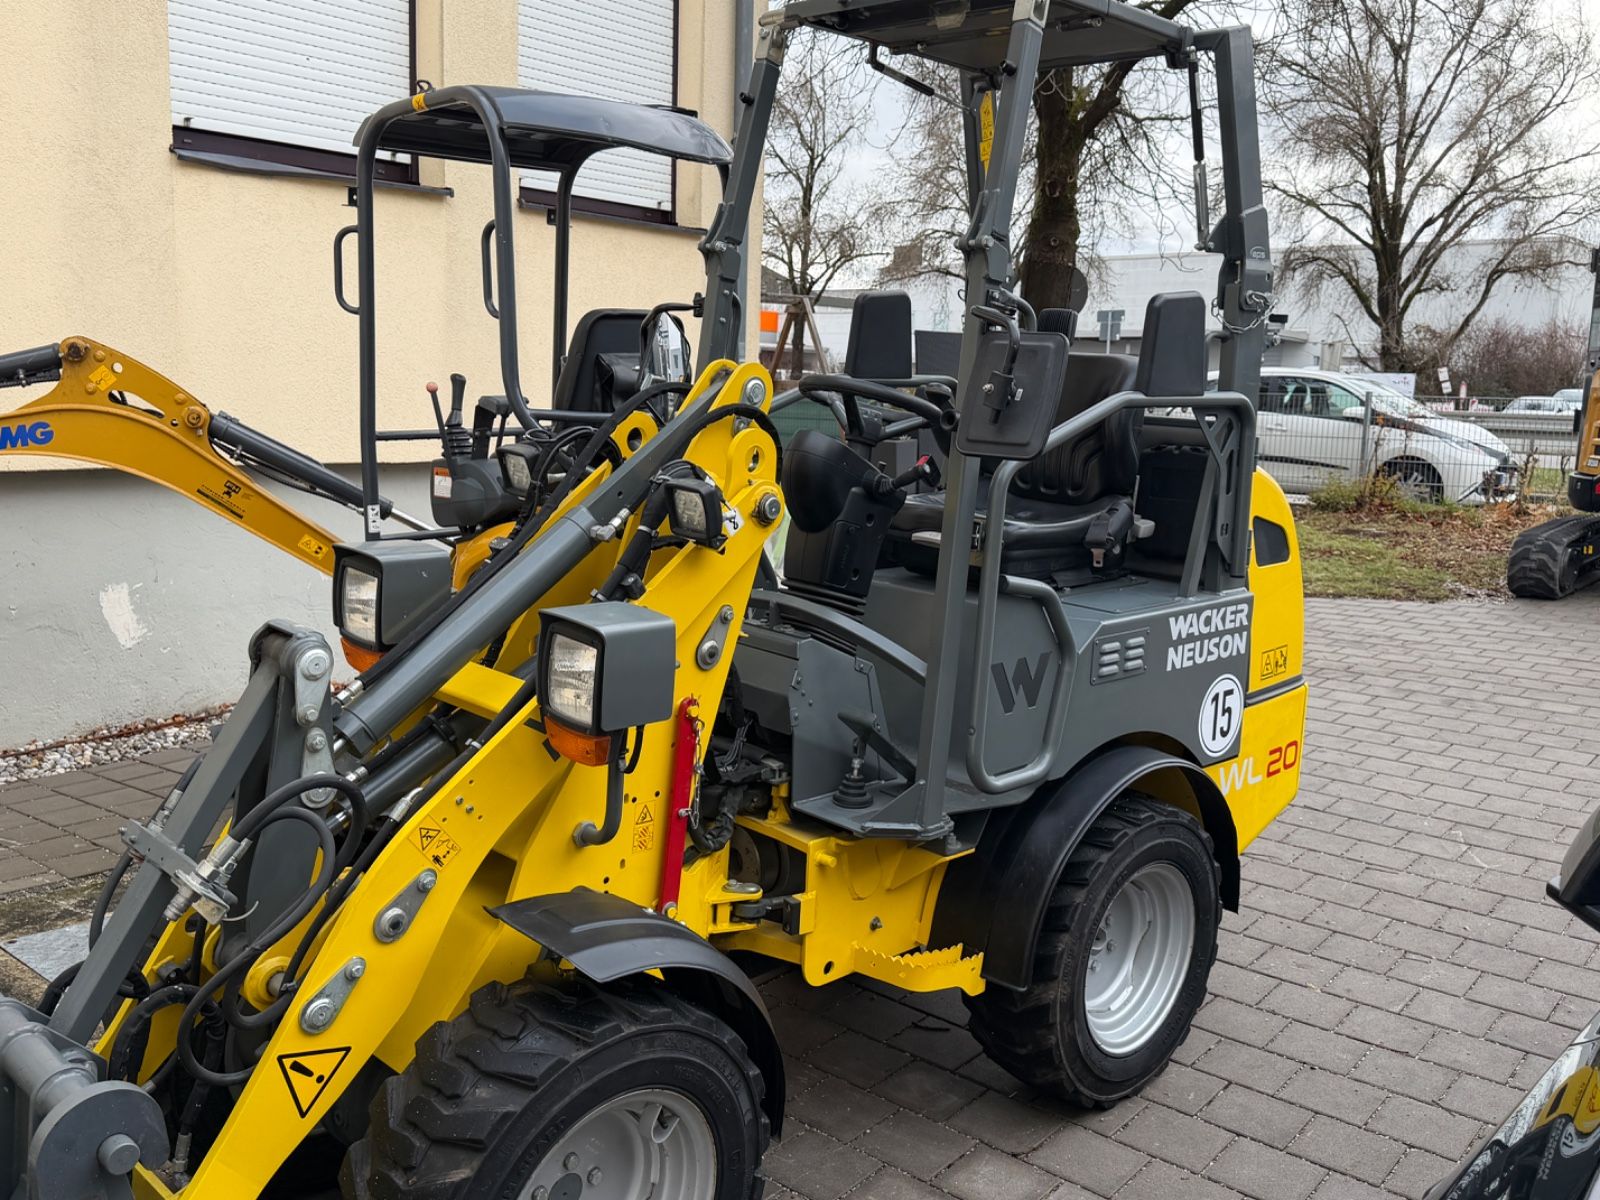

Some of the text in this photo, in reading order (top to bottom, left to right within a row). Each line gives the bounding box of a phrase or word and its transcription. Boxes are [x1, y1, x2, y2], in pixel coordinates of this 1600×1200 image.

[1169, 604, 1248, 640] WACKER
[1166, 631, 1247, 671] NEUSON
[991, 651, 1051, 713] W
[1211, 688, 1234, 741] 15
[1219, 740, 1298, 797] WL 20
